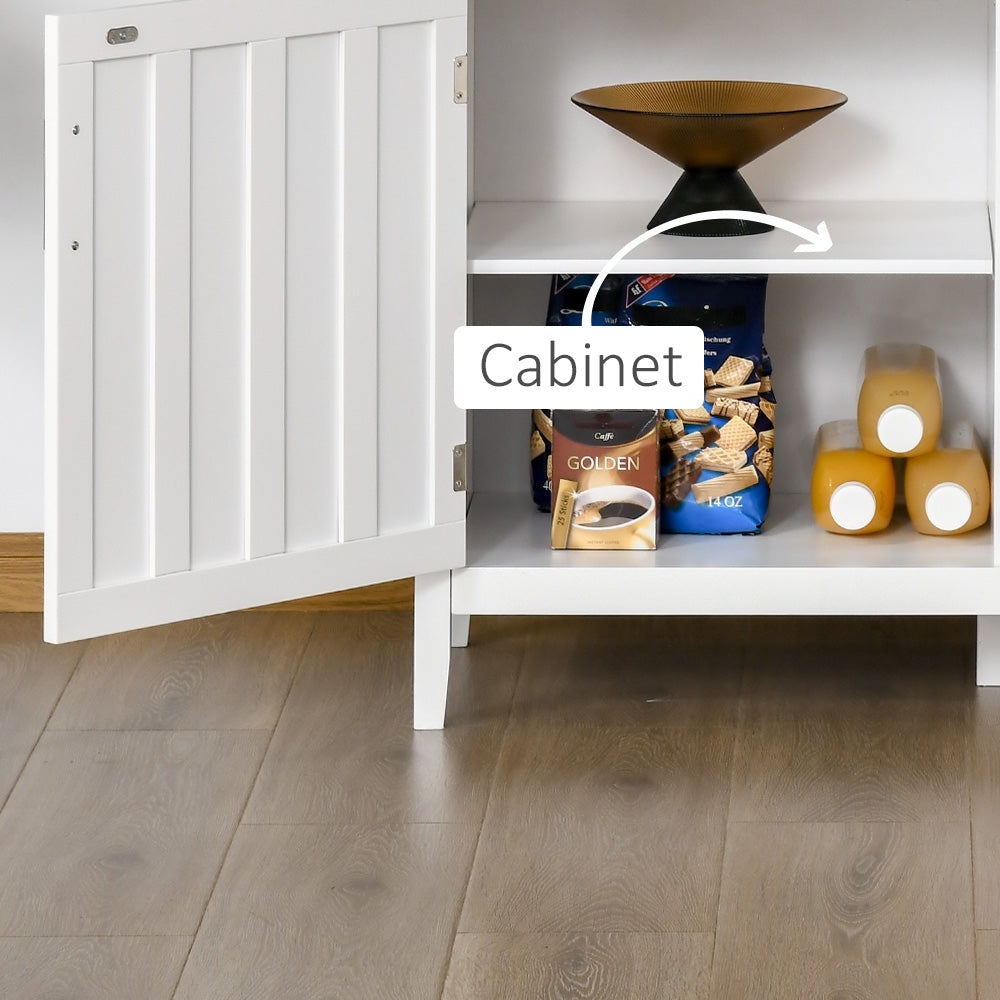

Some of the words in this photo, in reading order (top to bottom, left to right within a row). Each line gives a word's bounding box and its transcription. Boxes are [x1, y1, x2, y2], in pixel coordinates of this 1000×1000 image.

[704, 336, 731, 344] ischung
[567, 456, 640, 471] GOLDEN
[559, 495, 570, 515] Sticks
[706, 495, 722, 508] 14
[723, 495, 744, 508] OZ
[556, 512, 565, 526] 25
